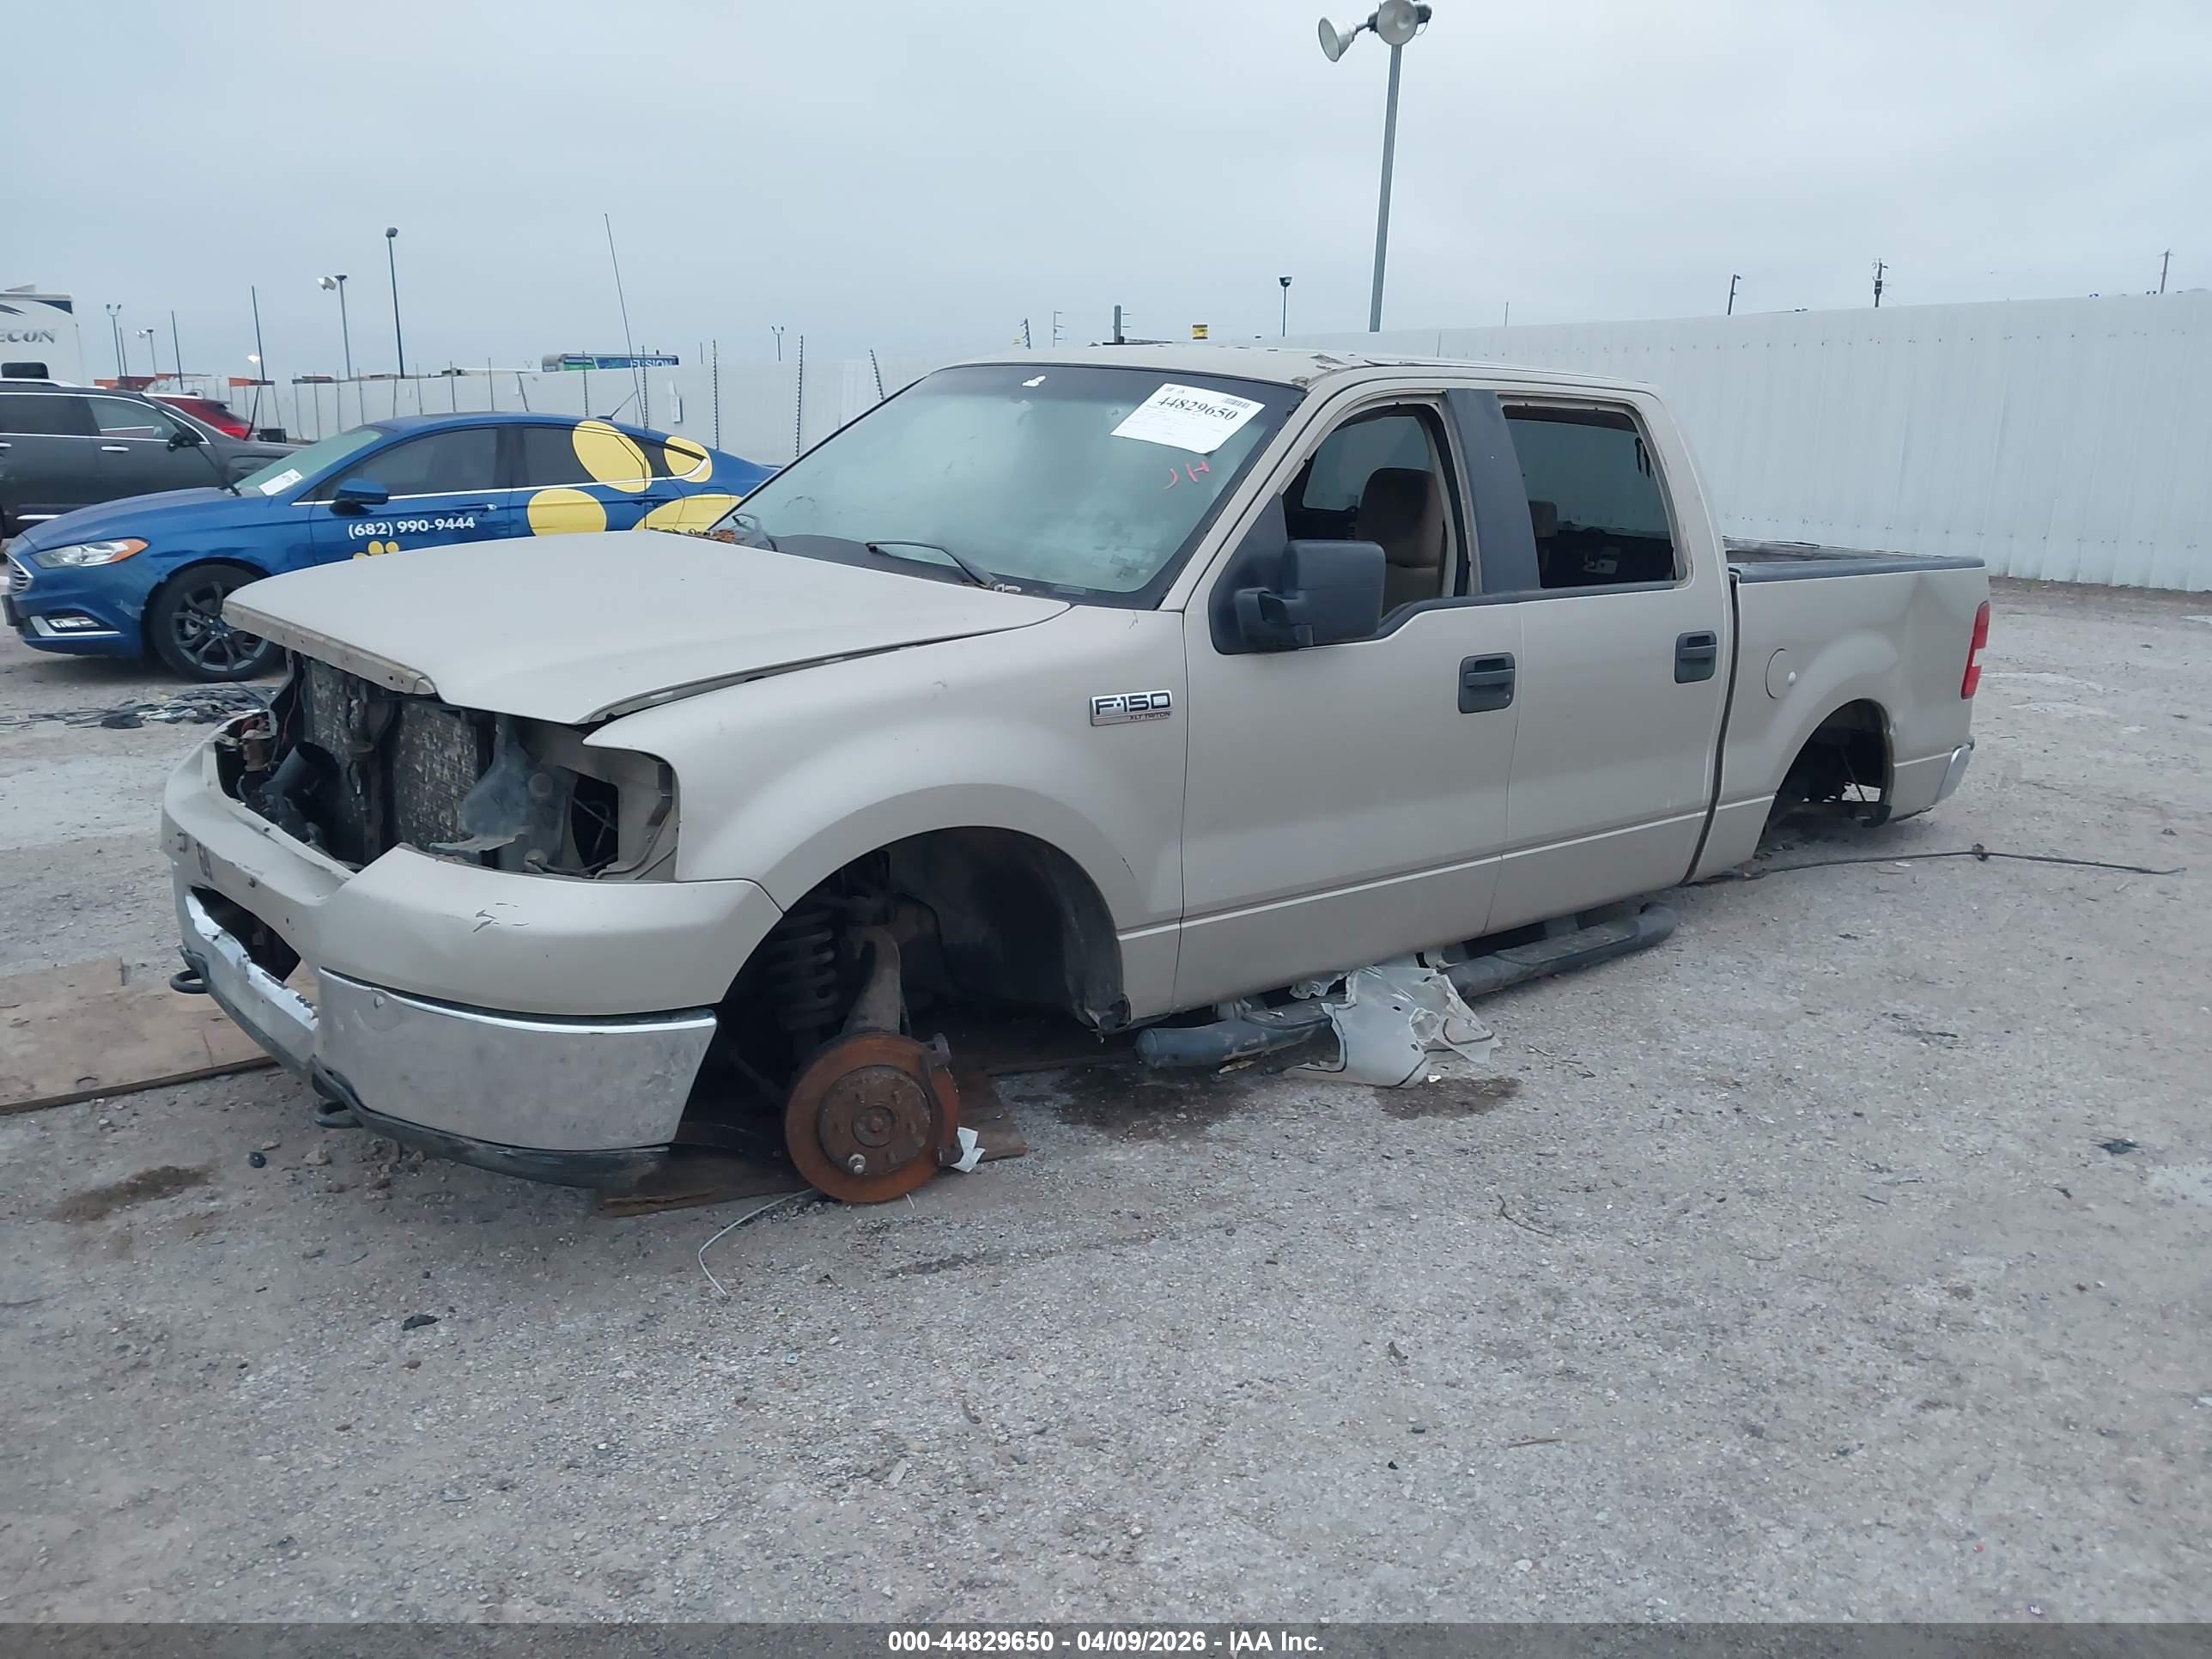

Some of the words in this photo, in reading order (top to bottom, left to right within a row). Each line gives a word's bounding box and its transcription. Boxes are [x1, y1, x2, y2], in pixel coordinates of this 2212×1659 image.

[1158, 396, 1238, 421] 44829650
[348, 520, 393, 539] (682)
[397, 517, 476, 533] 990-9444
[1095, 692, 1171, 715] F-150
